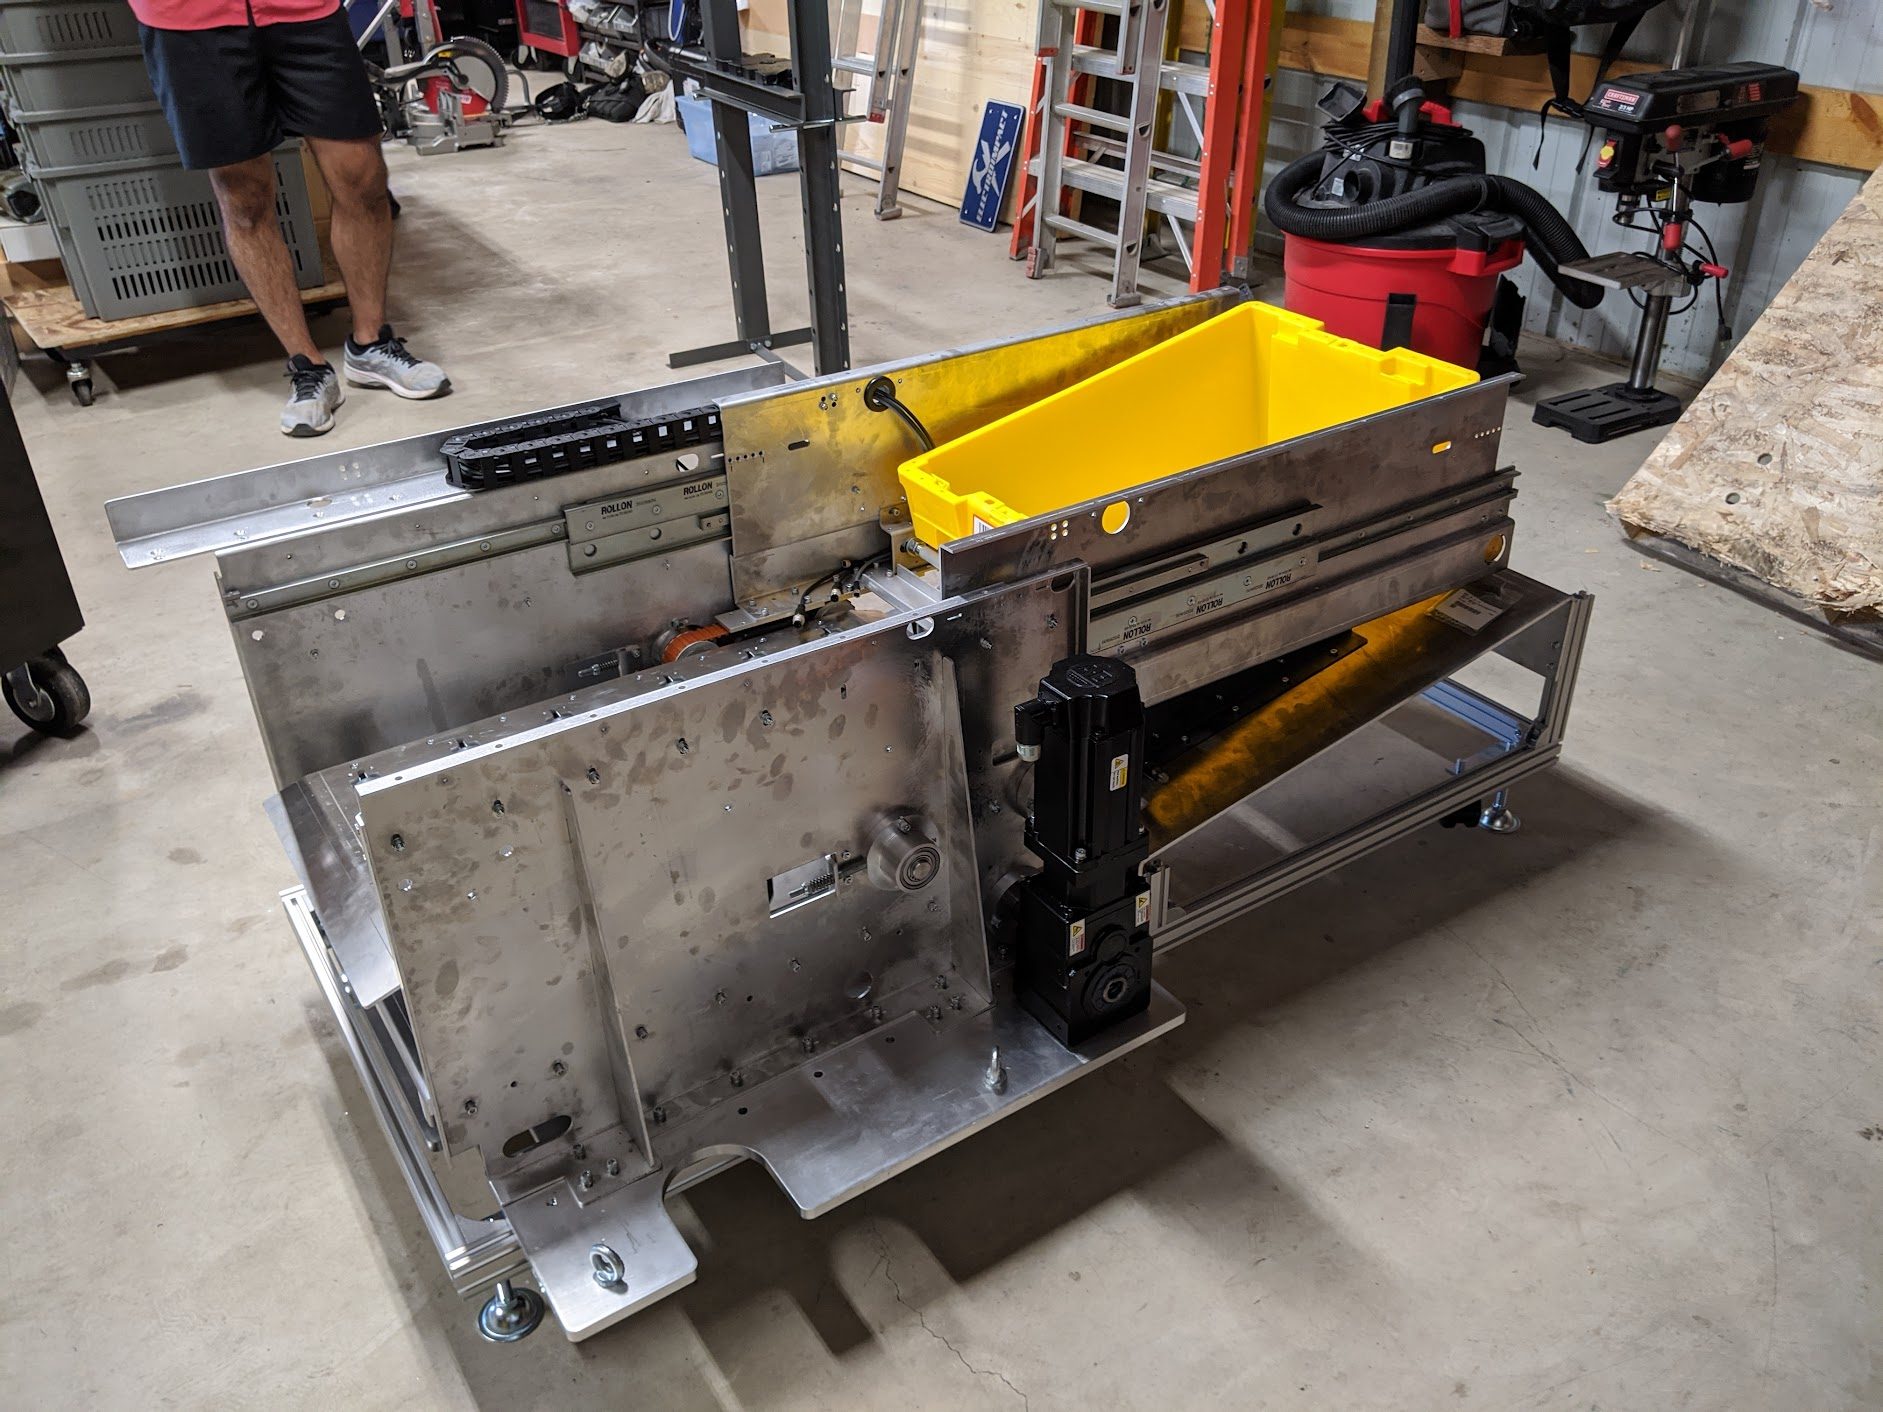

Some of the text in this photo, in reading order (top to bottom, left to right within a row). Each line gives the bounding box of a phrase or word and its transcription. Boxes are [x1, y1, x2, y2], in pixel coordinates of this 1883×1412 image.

[683, 481, 713, 496] ROLLON
[601, 500, 633, 515] ROLLON
[1265, 573, 1292, 590] ROLLON
[1196, 597, 1224, 615] ROLLON
[1123, 623, 1152, 640] ROLLON
